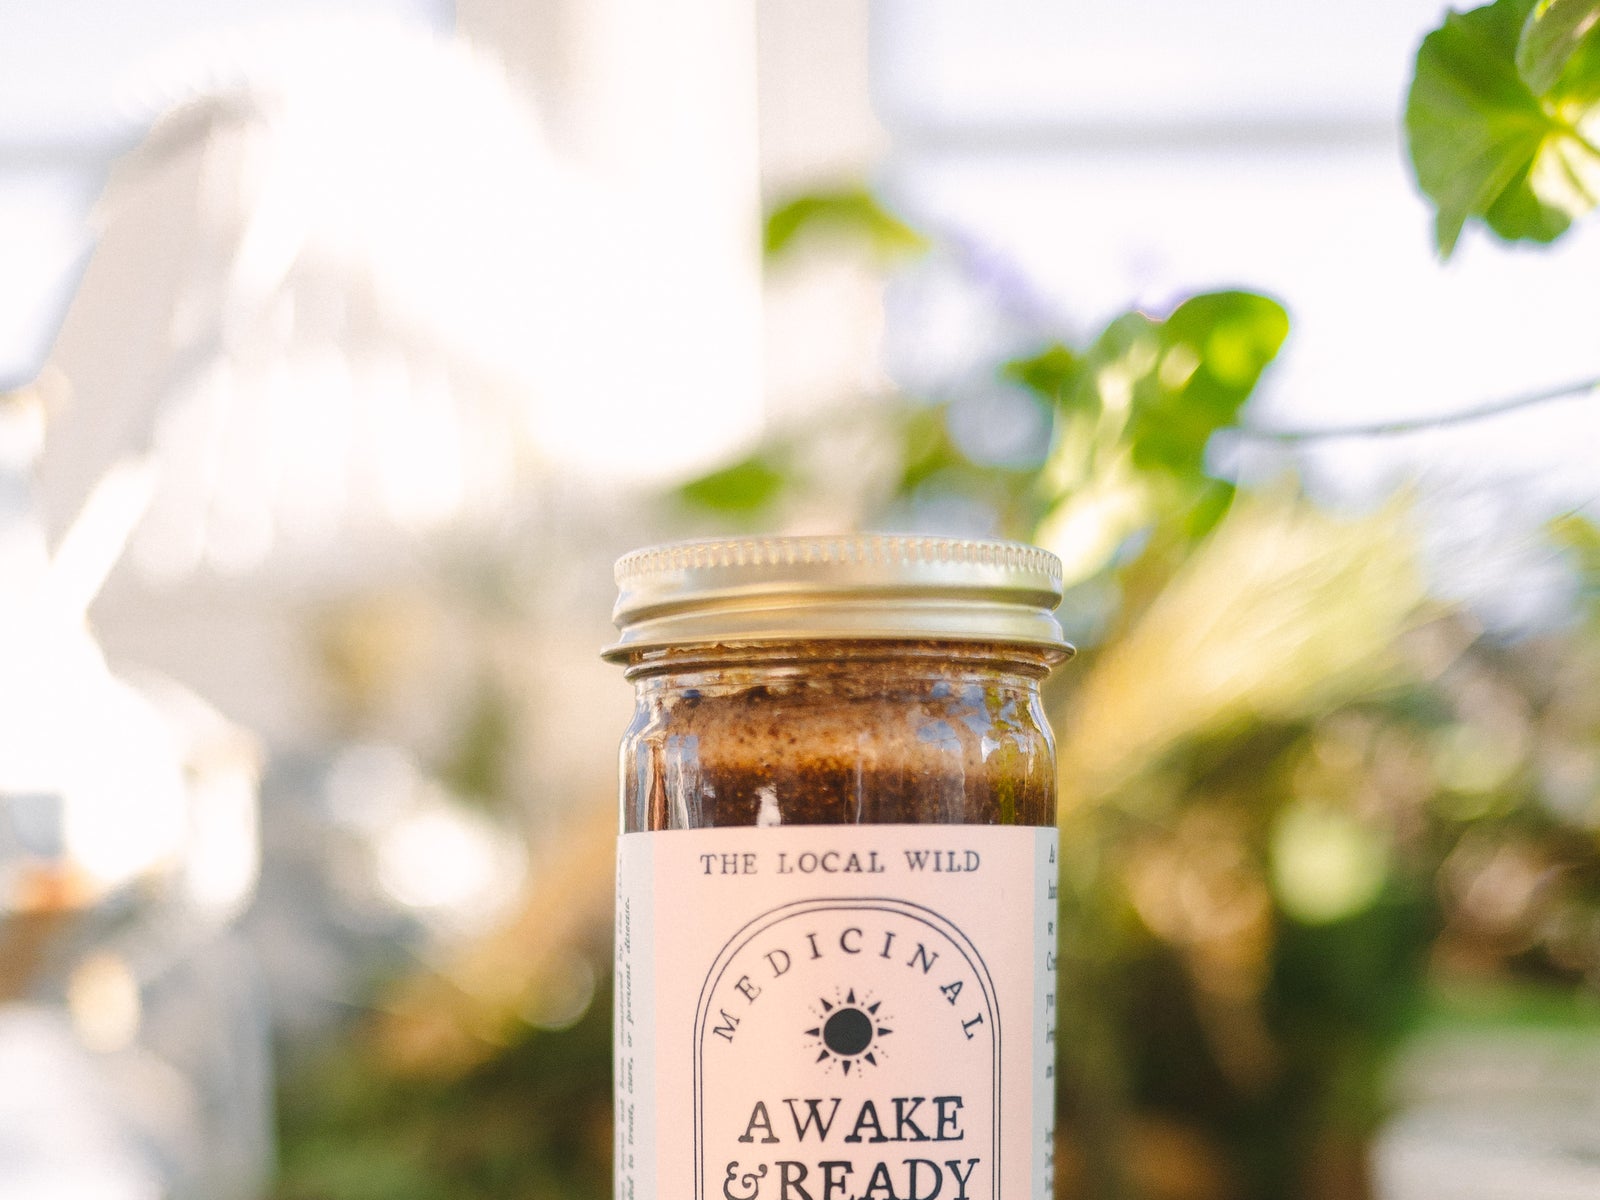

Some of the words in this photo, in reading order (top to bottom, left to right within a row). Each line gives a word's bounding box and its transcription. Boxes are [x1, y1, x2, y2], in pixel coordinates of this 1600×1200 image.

[699, 853, 757, 875] THE
[778, 851, 885, 874] LOCAL
[903, 850, 980, 873] WILD
[713, 927, 985, 1044] MEDICINAL
[737, 1095, 965, 1144] AWAKE
